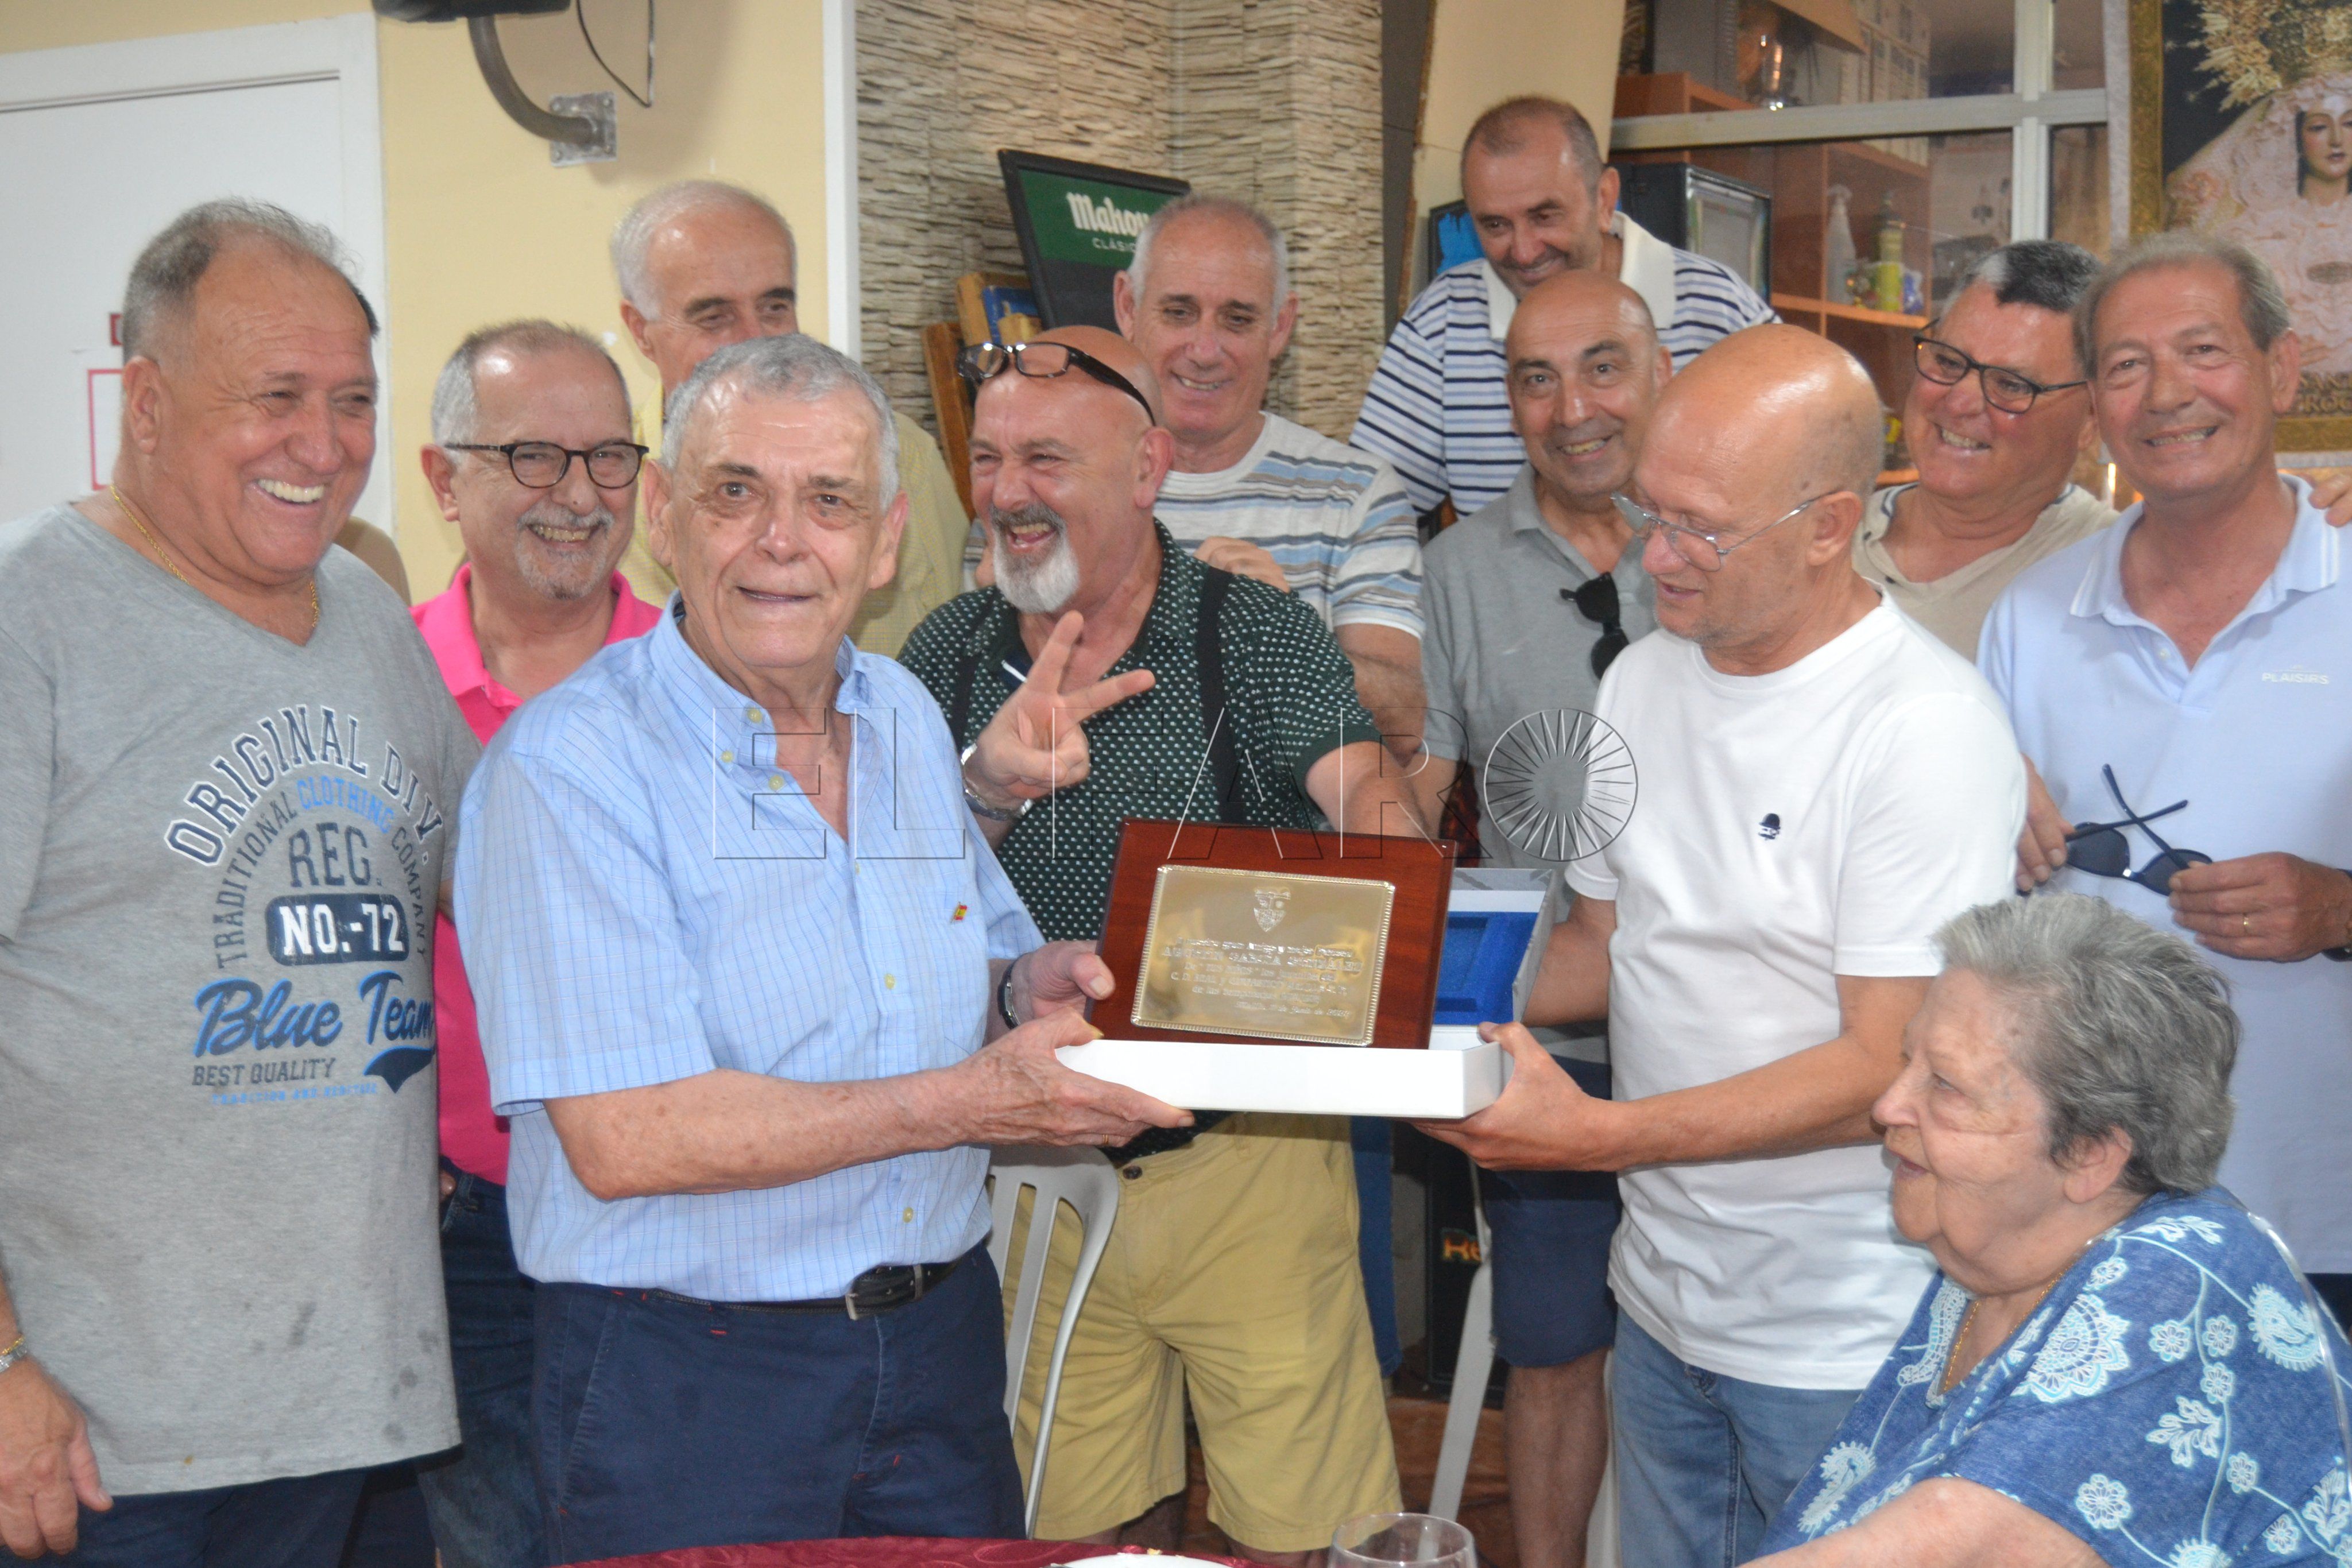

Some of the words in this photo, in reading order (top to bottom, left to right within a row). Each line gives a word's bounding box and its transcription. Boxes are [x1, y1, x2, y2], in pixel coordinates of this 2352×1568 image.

[164, 704, 368, 866] ORIGINAL
[213, 791, 297, 969] TRADITIONAL
[297, 776, 394, 834] CLOTHING
[392, 827, 425, 956] COMPANY
[289, 822, 382, 887] REG.
[193, 977, 343, 1057] Blue
[359, 970, 434, 1045] Team
[192, 1064, 245, 1087] BEST
[251, 1058, 336, 1082] QUALITY
